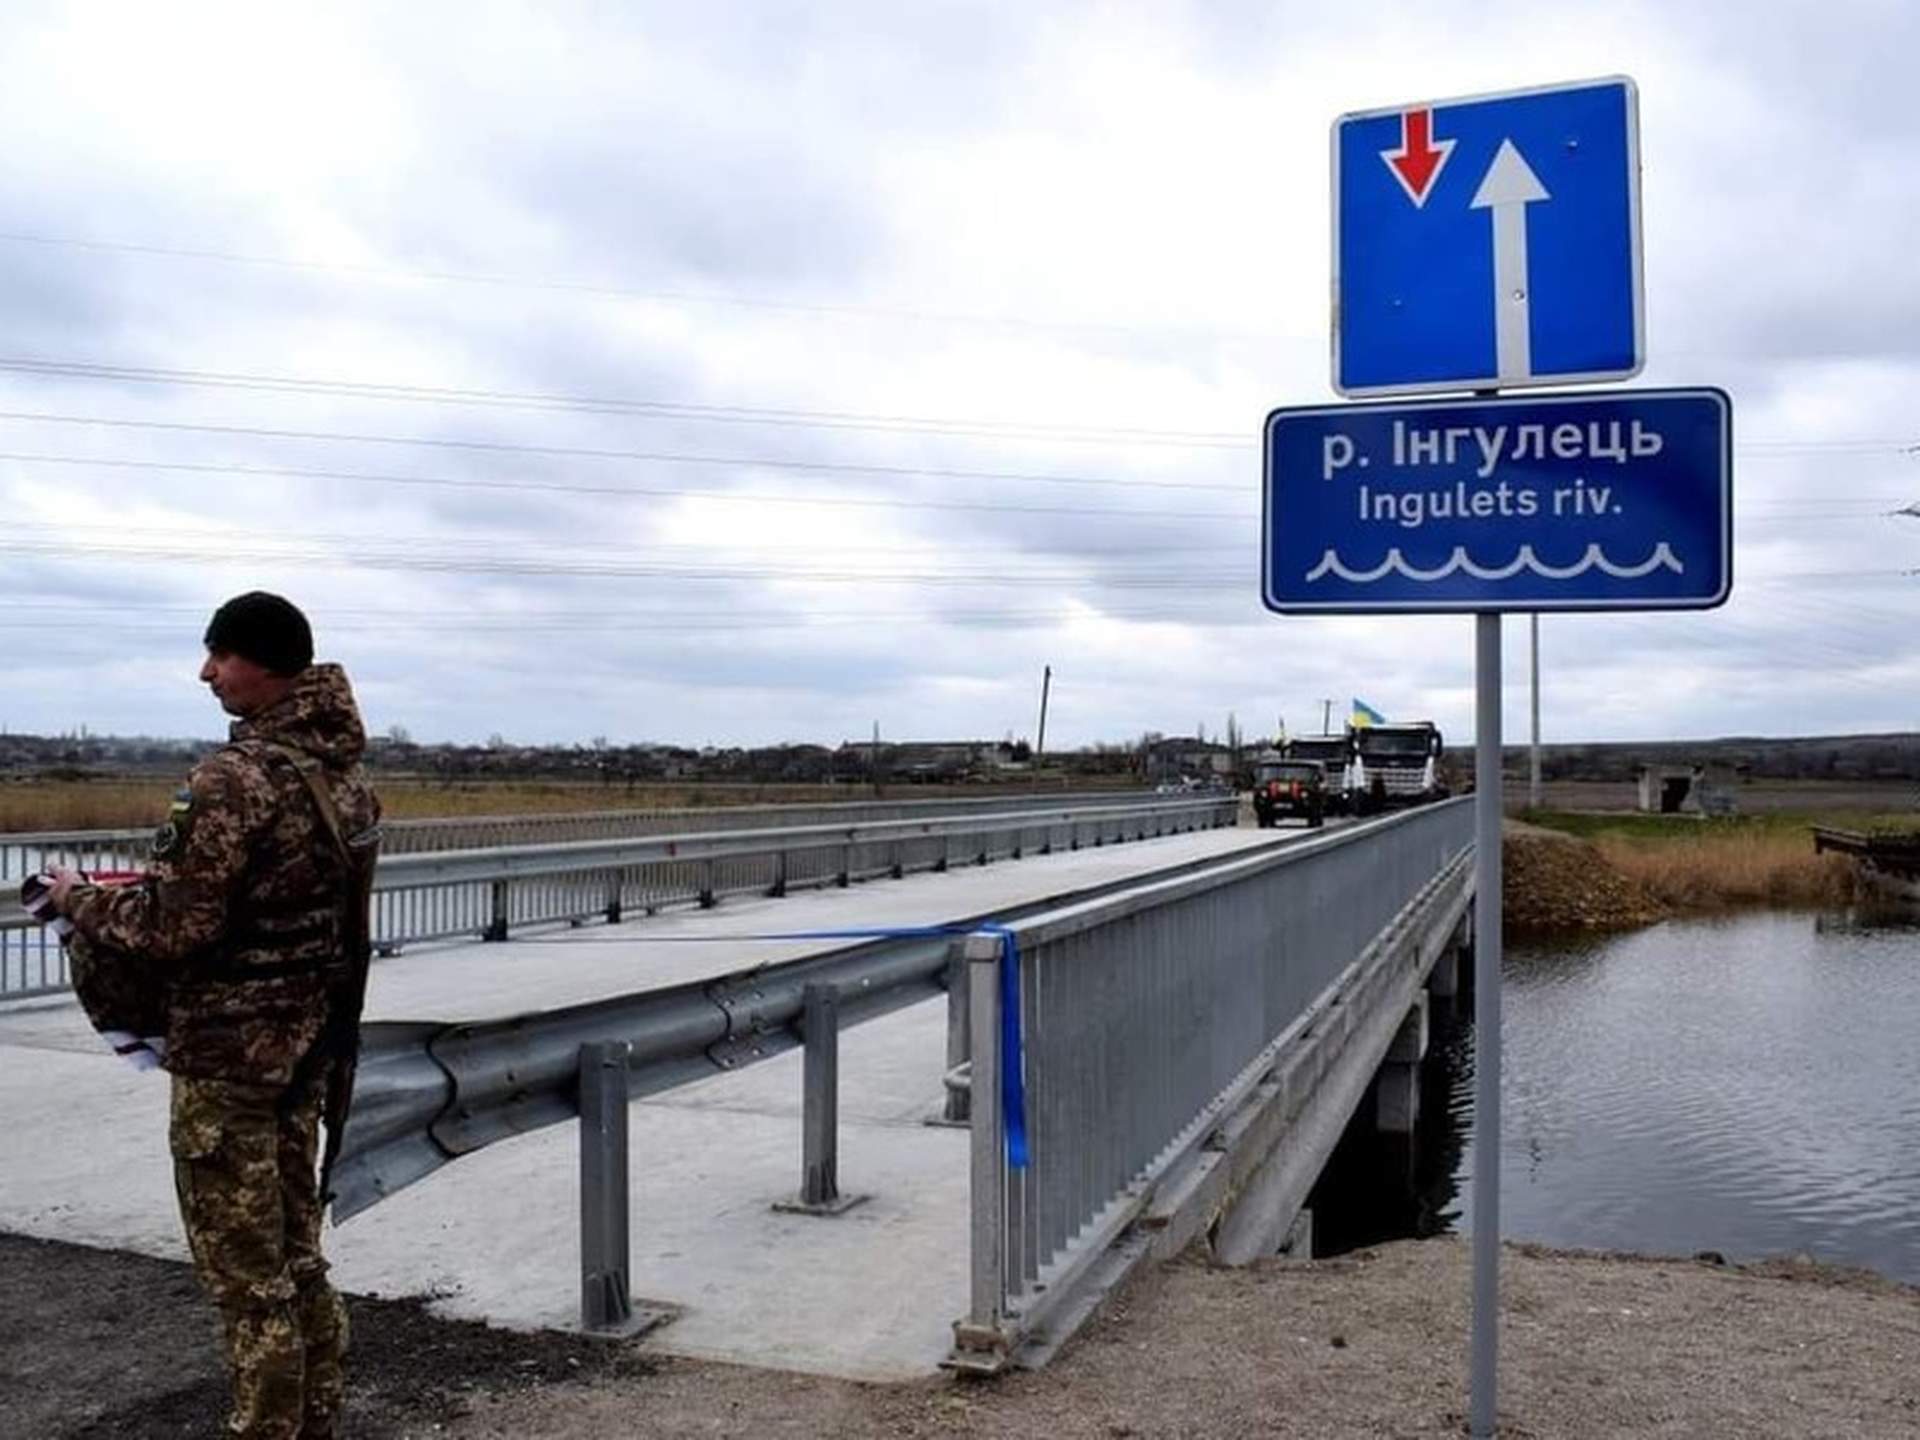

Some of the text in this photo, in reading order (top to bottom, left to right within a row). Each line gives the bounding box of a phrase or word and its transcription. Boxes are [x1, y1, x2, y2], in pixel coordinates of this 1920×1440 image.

[1323, 420, 1664, 480] р. Інгулець
[1359, 478, 1622, 528] Ingulets riv.
